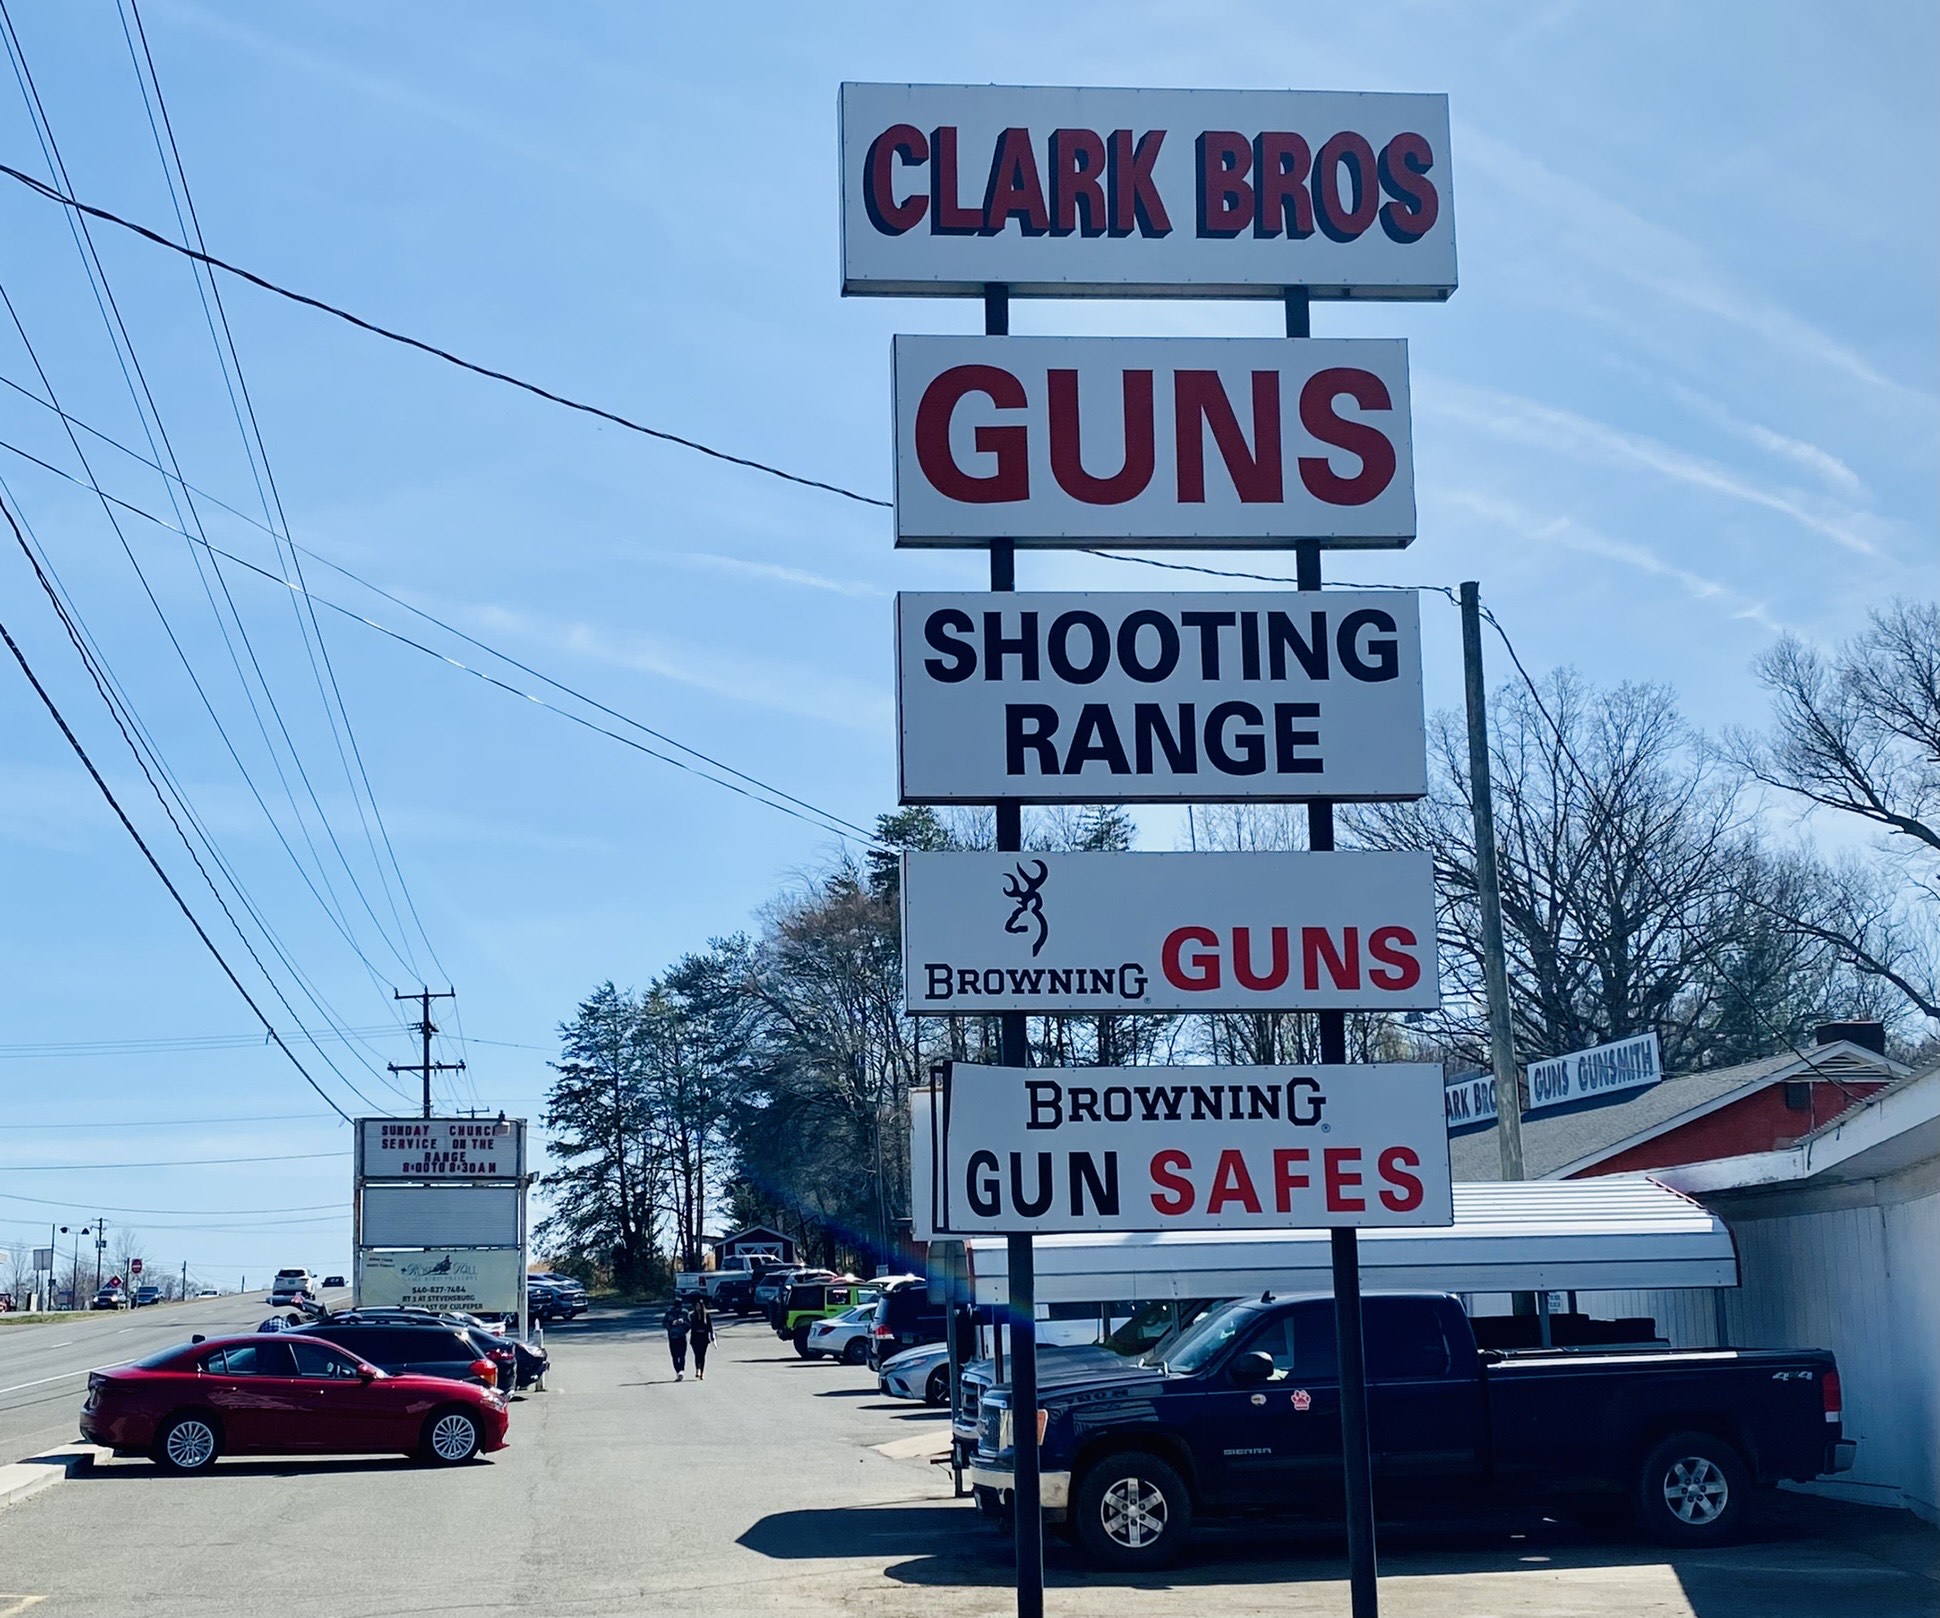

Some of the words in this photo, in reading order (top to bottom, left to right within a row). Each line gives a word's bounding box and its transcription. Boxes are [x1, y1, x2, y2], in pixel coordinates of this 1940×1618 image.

[863, 123, 1173, 239] CLARK
[1194, 130, 1439, 245] BROS
[915, 364, 1397, 506] GUNS
[924, 608, 1400, 685] SHOOTING
[1005, 700, 1325, 775] RANGE
[924, 963, 1149, 1000] BROWNING
[1162, 926, 1422, 991] GUNS
[1534, 1060, 1570, 1102] GUNS
[1577, 1040, 1654, 1091] GUNSMITH
[381, 1125, 430, 1136] SUNDAY
[1025, 1077, 1327, 1130] BROWNING
[381, 1138, 437, 1150] SERVICE
[452, 1139, 466, 1150] ON
[471, 1139, 494, 1150] THE
[424, 1151, 467, 1163] RANGE
[966, 1149, 1121, 1218] GUN
[1149, 1147, 1424, 1215] SAFES
